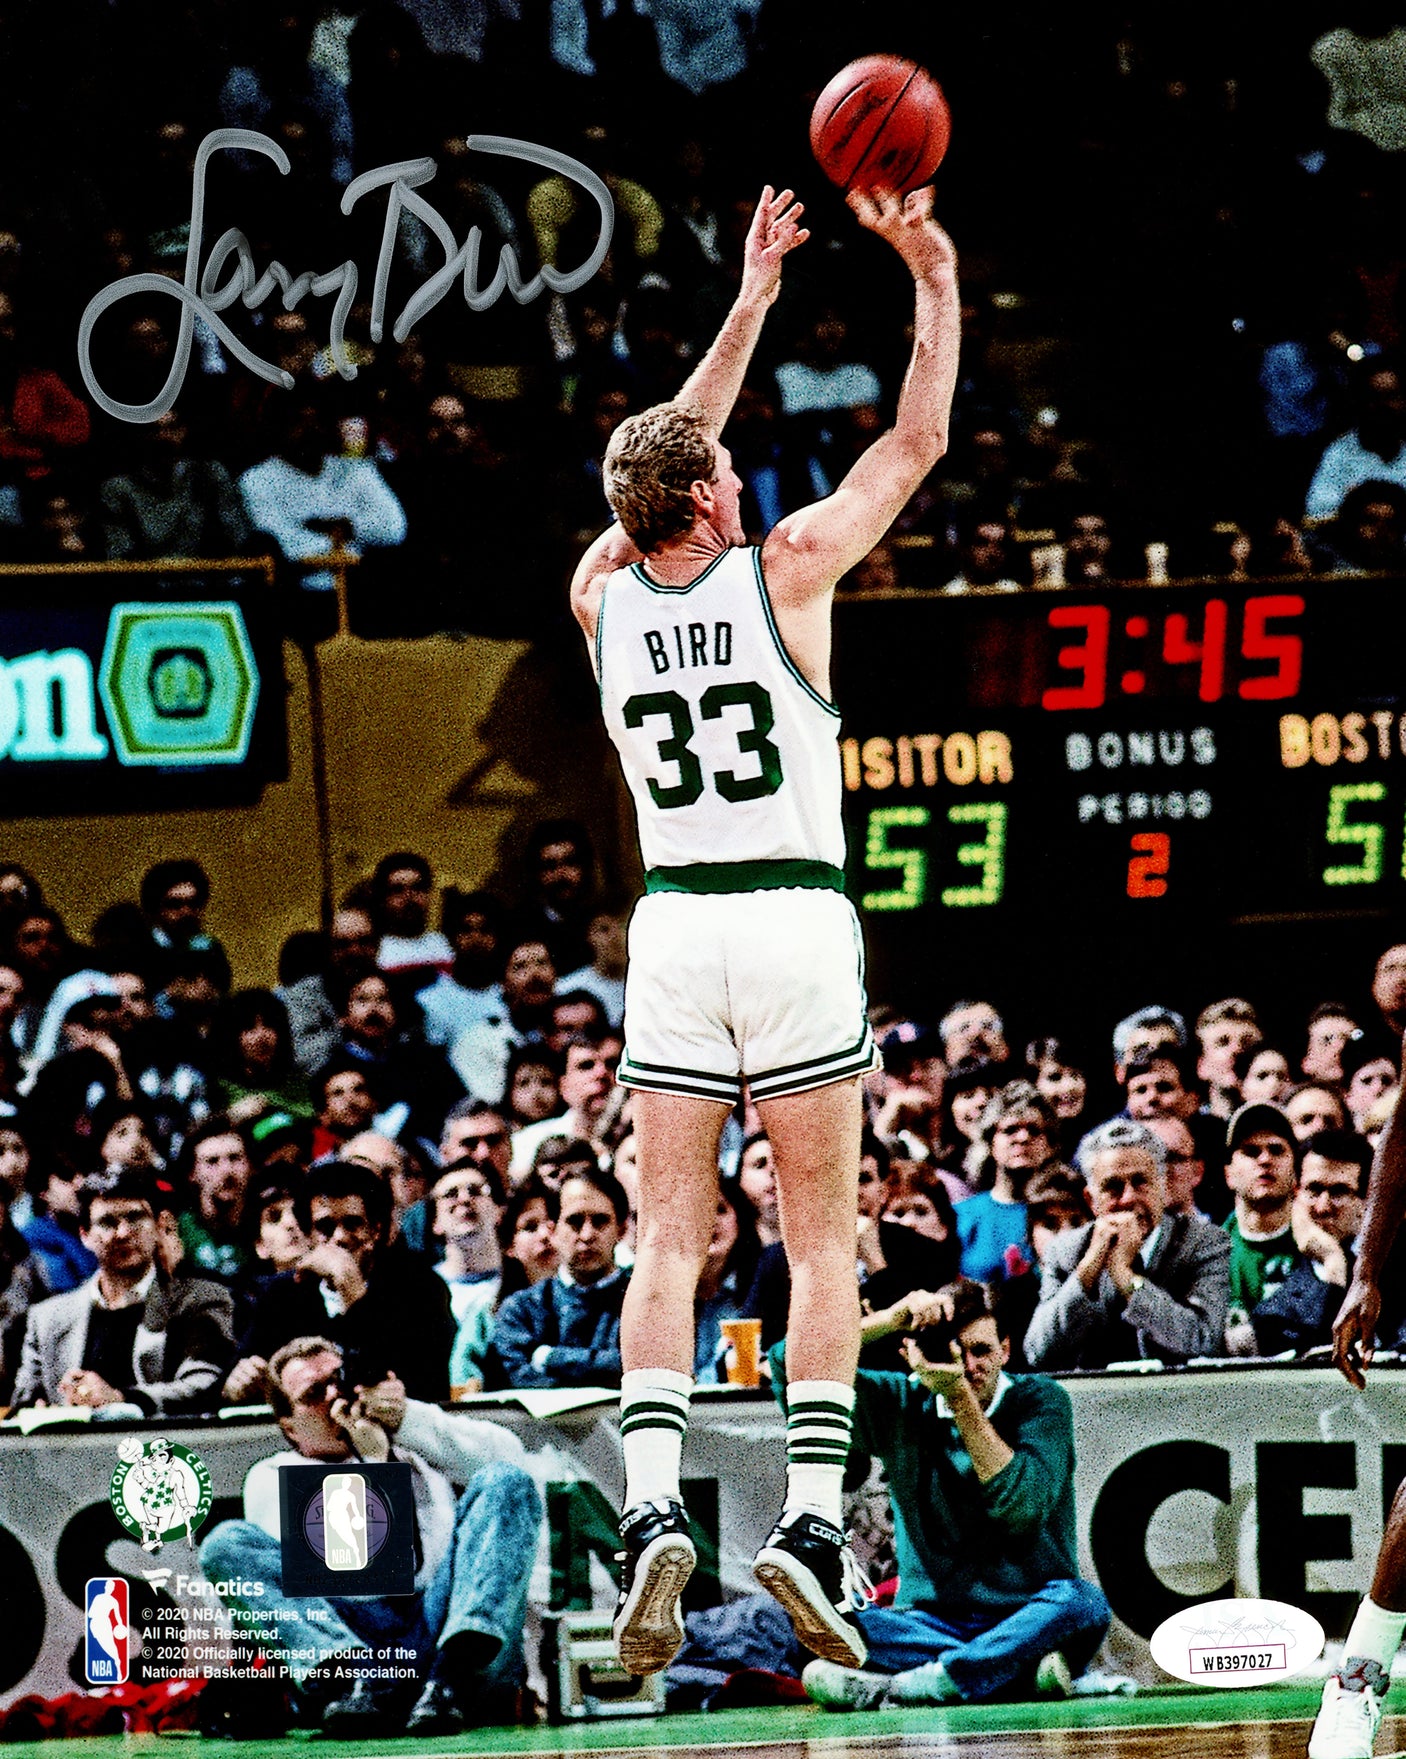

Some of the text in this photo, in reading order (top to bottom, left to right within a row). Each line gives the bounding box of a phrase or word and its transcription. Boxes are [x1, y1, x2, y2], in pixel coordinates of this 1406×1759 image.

[644, 621, 733, 675] BIRD
[1042, 595, 1306, 711] 3:45
[622, 680, 784, 809] 33
[841, 730, 1014, 791] ISITOR
[1065, 726, 1217, 771] BONUS
[1279, 710, 1406, 768] BOST
[862, 802, 1008, 911] 53
[1126, 832, 1170, 898] 2
[1322, 782, 1406, 885] 5
[1090, 1439, 1406, 1655] CE
